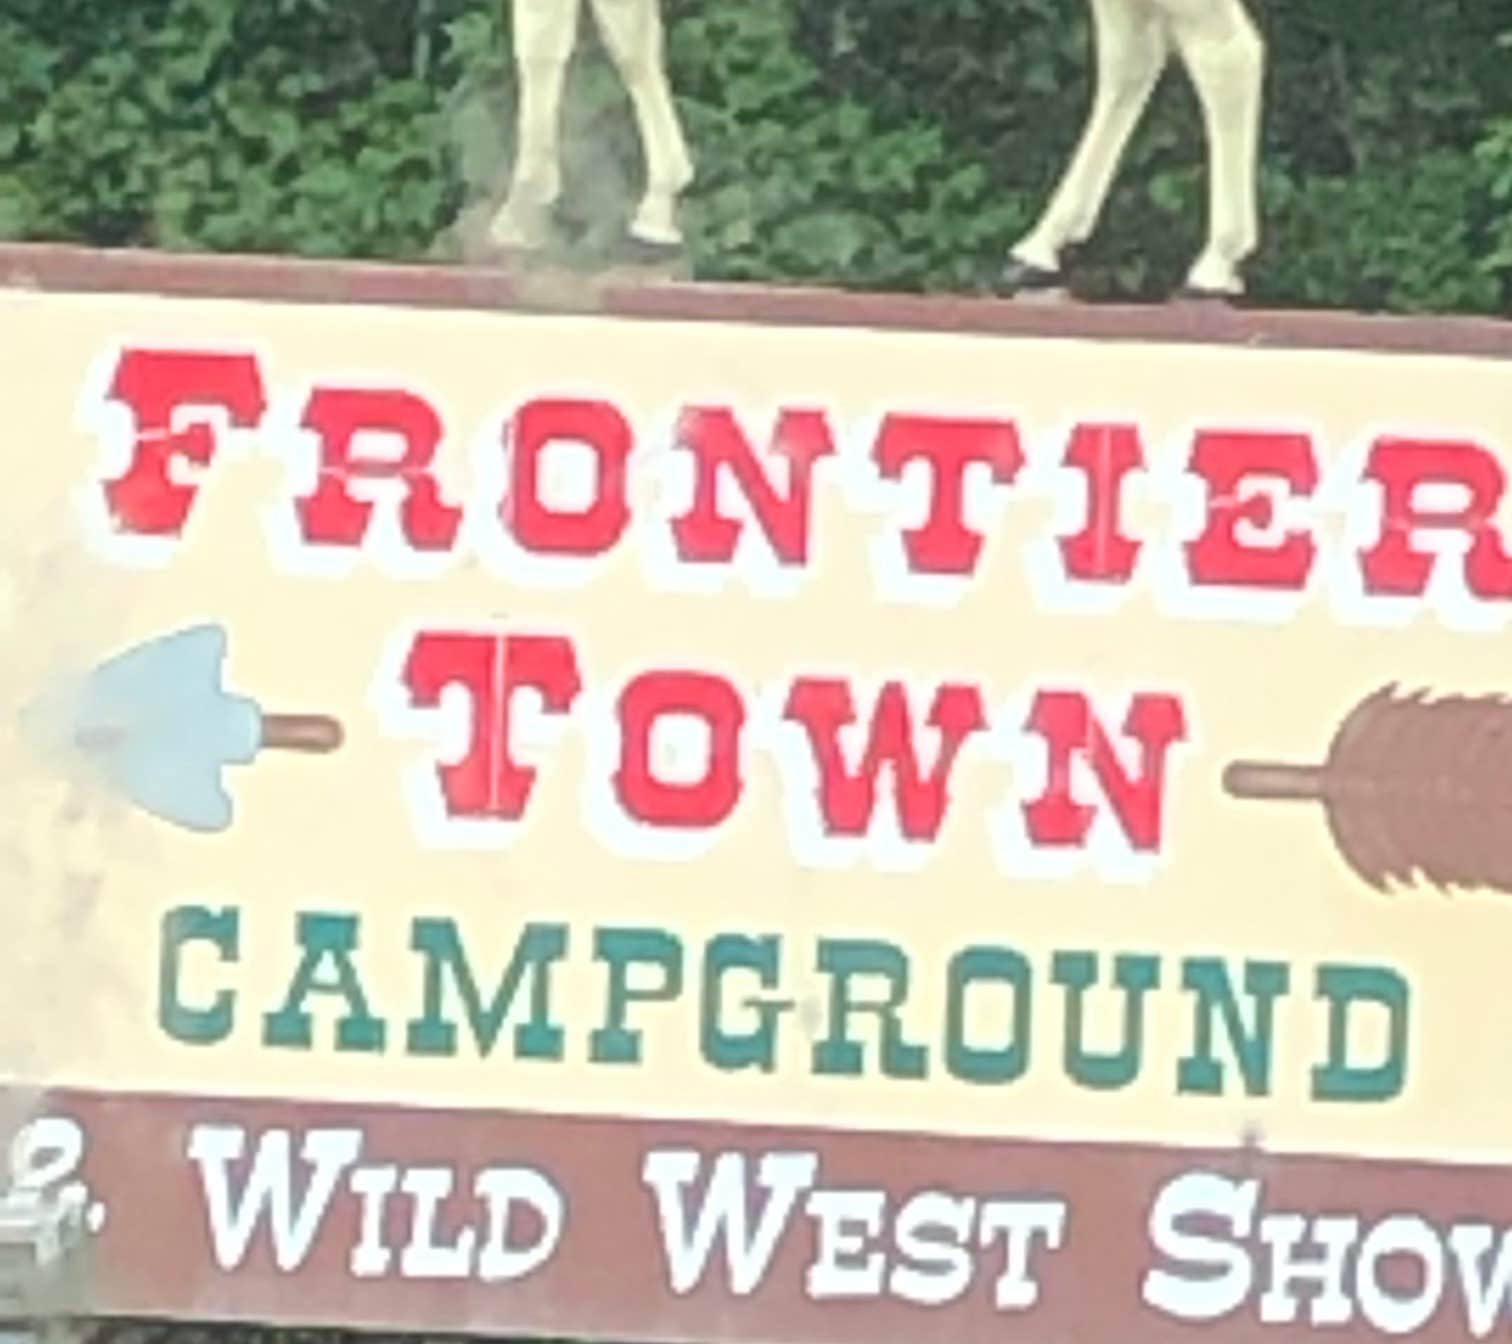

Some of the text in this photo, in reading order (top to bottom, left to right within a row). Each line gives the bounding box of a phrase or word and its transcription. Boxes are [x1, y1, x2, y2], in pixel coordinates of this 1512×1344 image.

[400, 630, 1190, 854] TOWN
[156, 903, 1412, 1104] CAMPGROUND
[187, 1122, 566, 1281] WILD
[641, 1147, 1066, 1312] WEST
